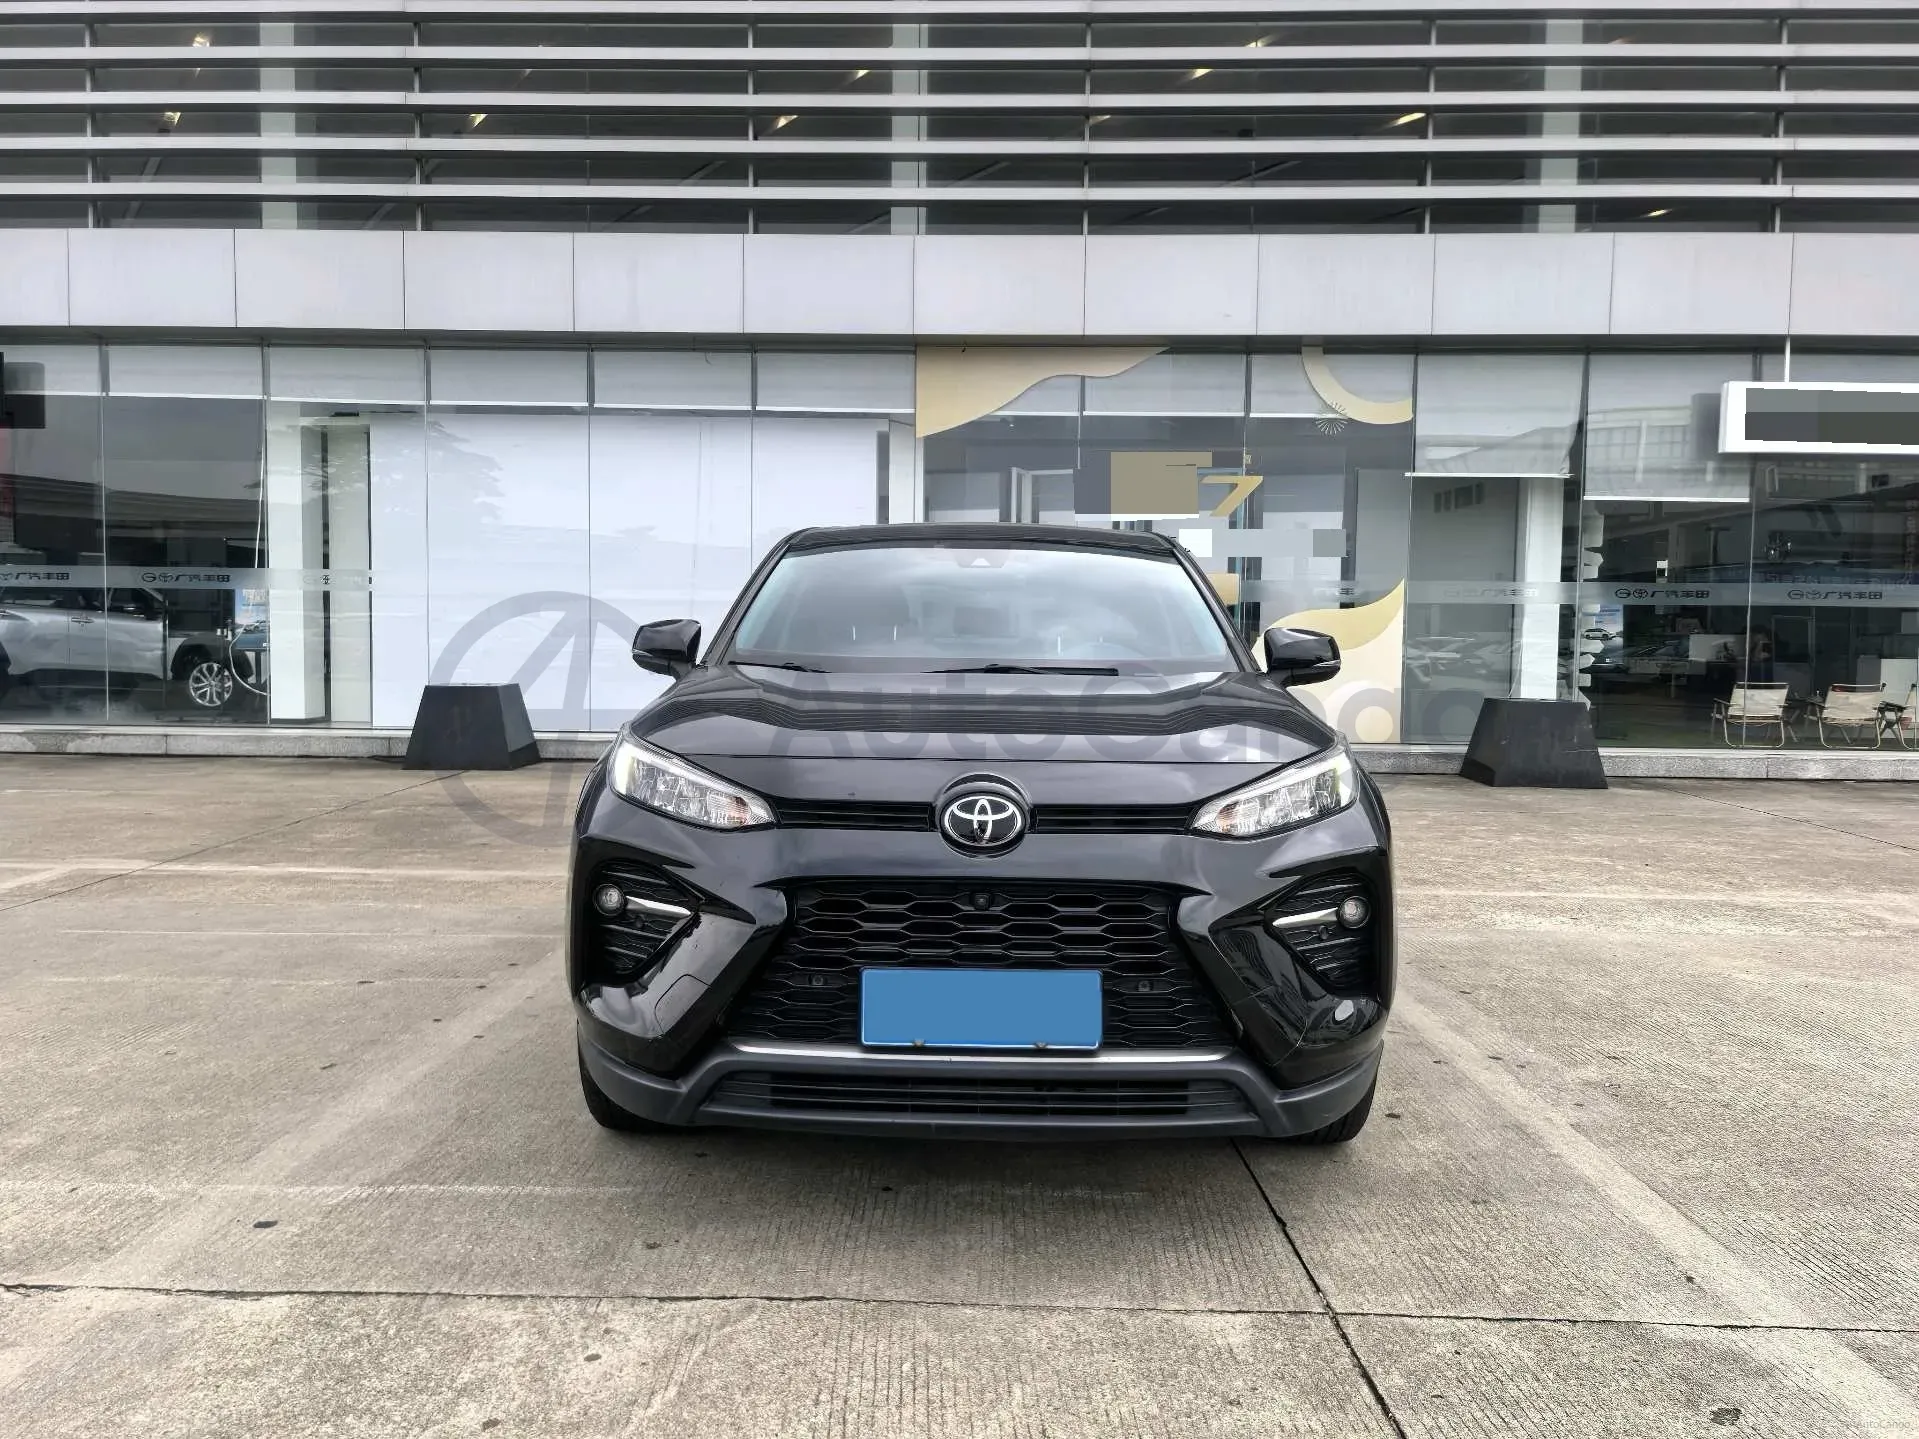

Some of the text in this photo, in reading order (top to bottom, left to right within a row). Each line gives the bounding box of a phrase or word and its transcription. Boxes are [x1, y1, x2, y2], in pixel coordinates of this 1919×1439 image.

[1201, 475, 1264, 517] 7
[1650, 590, 1710, 599] 广汽丰田
[1822, 591, 1883, 600] 广汽丰田
